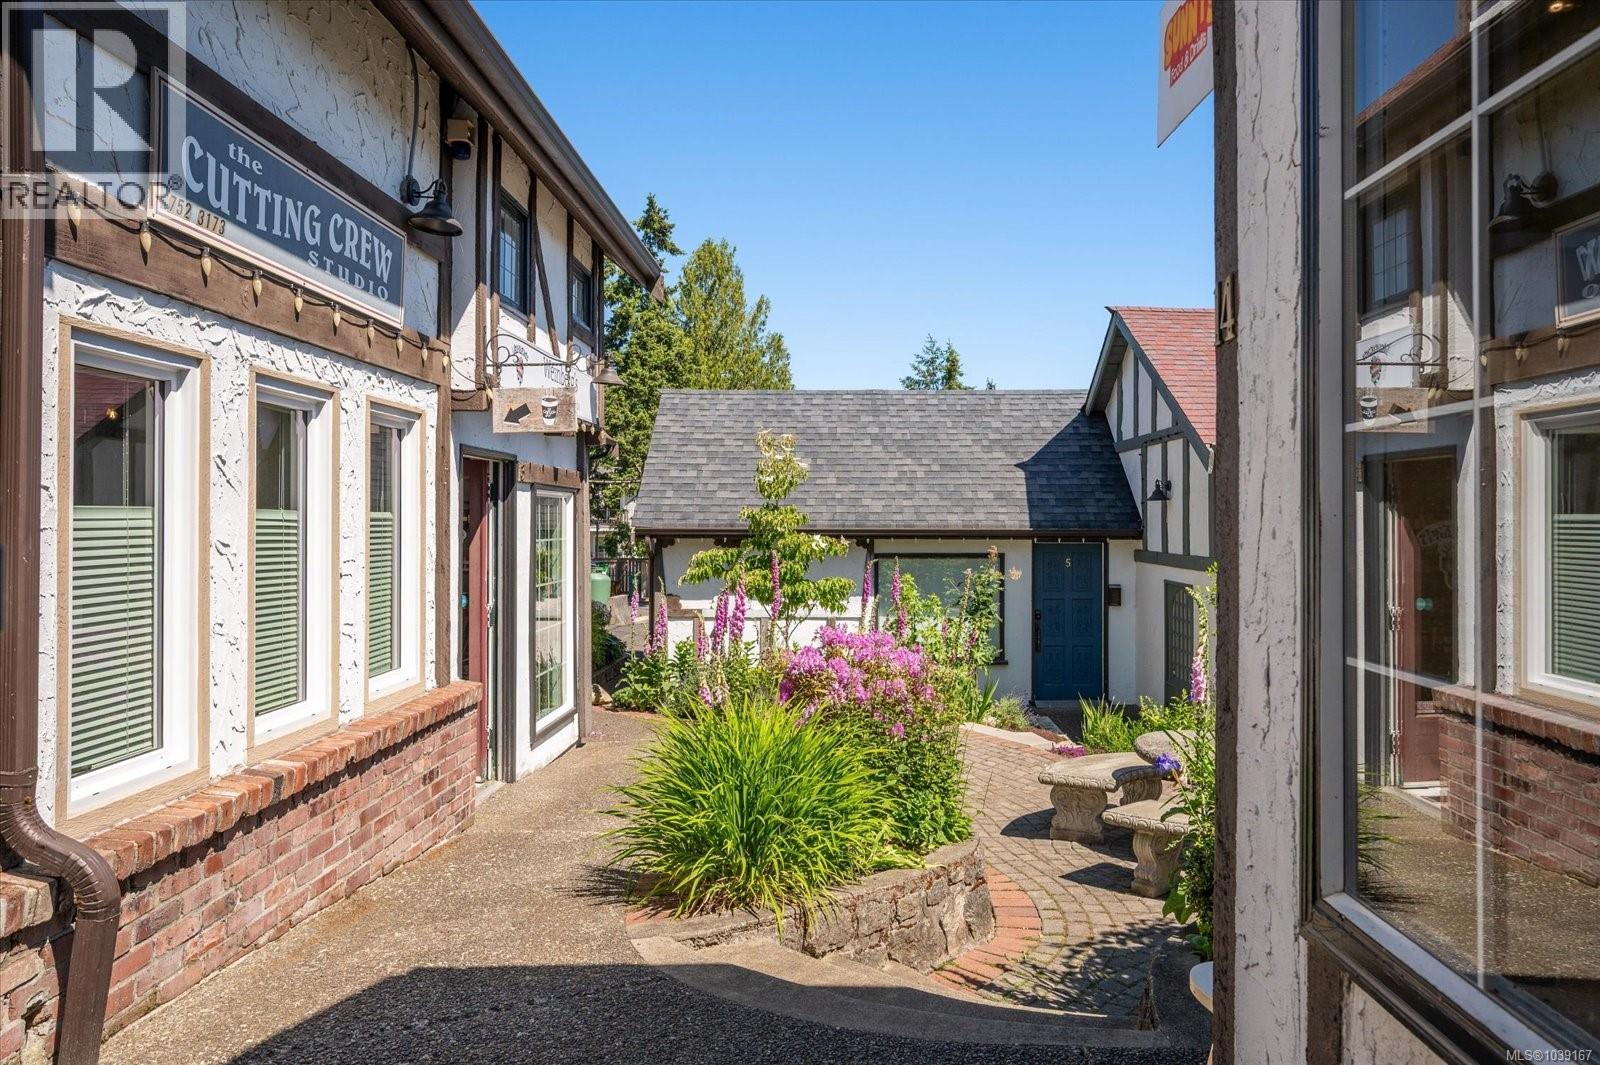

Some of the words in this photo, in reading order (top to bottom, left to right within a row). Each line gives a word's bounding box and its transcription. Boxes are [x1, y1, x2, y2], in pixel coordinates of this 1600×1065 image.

[228, 142, 264, 176] the
[168, 194, 192, 220] 752
[197, 209, 226, 235] 3173
[181, 135, 322, 247] CUTTING
[328, 212, 394, 284] CREW
[307, 250, 389, 301] STUDIO
[1065, 558, 1071, 568] 5
